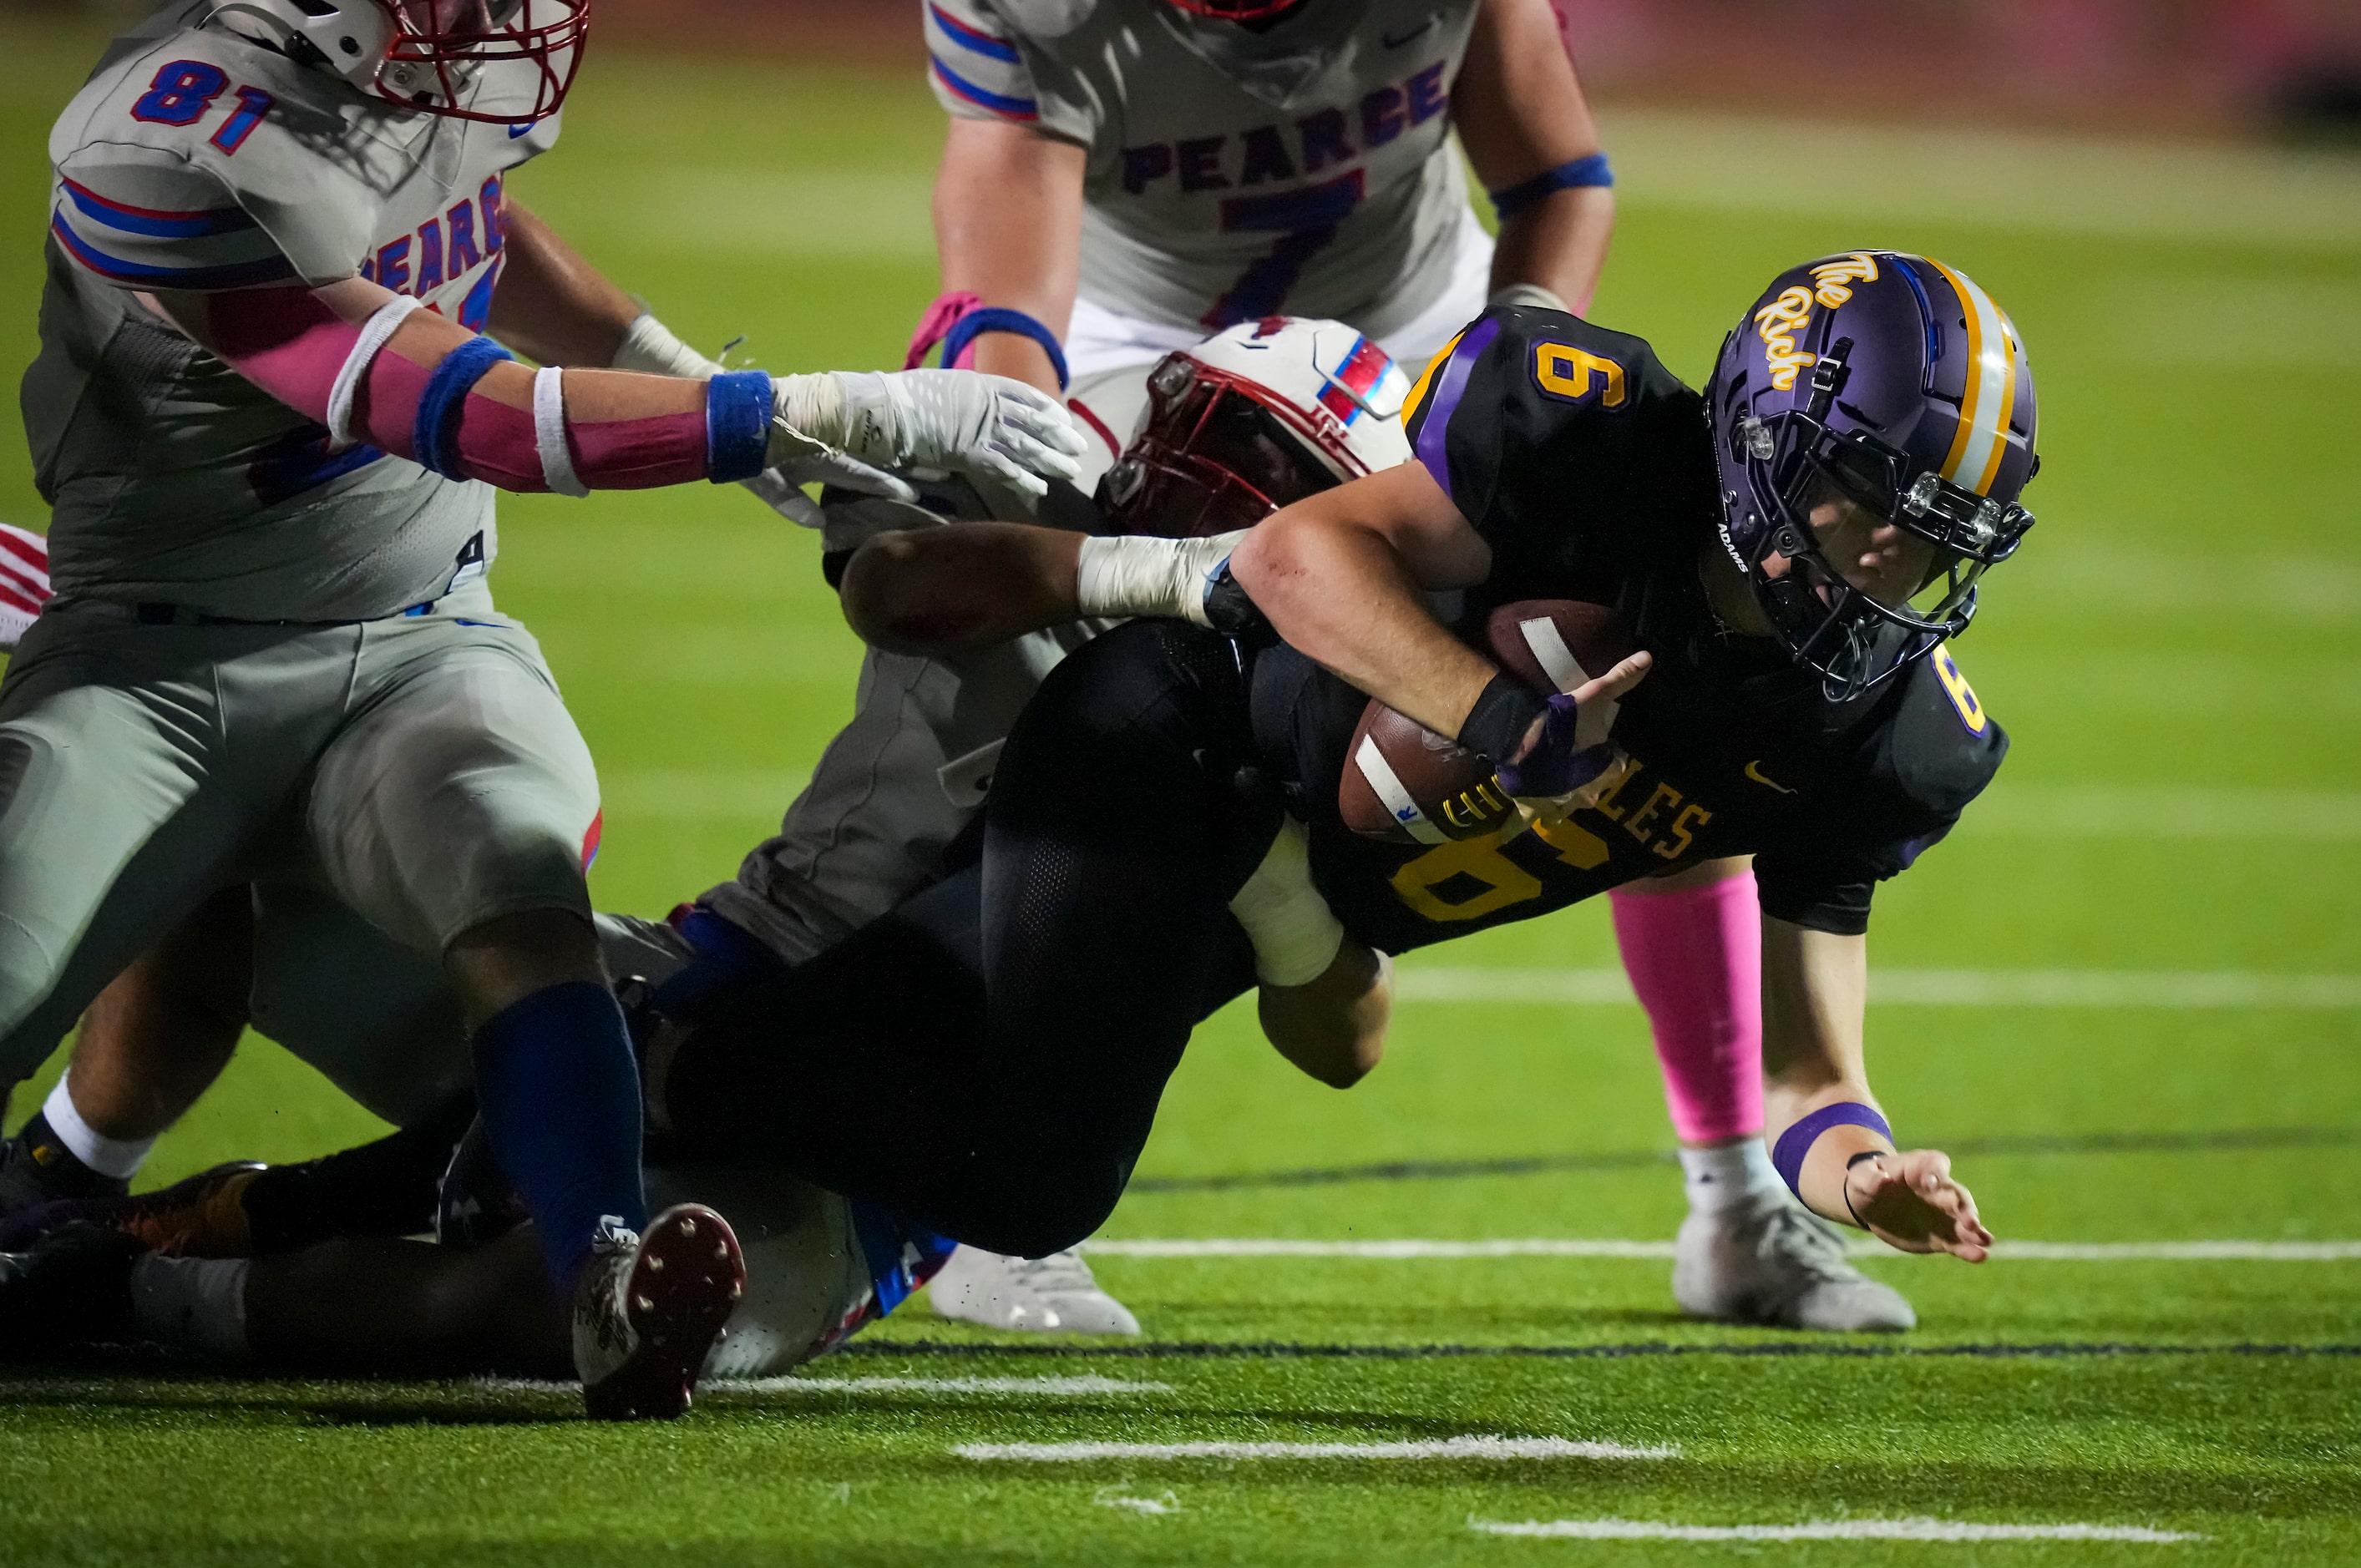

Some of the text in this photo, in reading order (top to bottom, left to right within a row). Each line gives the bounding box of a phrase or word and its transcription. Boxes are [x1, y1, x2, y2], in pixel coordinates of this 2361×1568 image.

[129, 59, 275, 157] 81
[1121, 60, 1449, 195] PEARCE
[1199, 167, 1366, 330] 7
[1808, 254, 1879, 309] The
[1532, 340, 1627, 409] 6
[1754, 286, 1817, 392] Rich
[1717, 523, 1749, 573] ADAMS
[1595, 758, 1712, 860] LES
